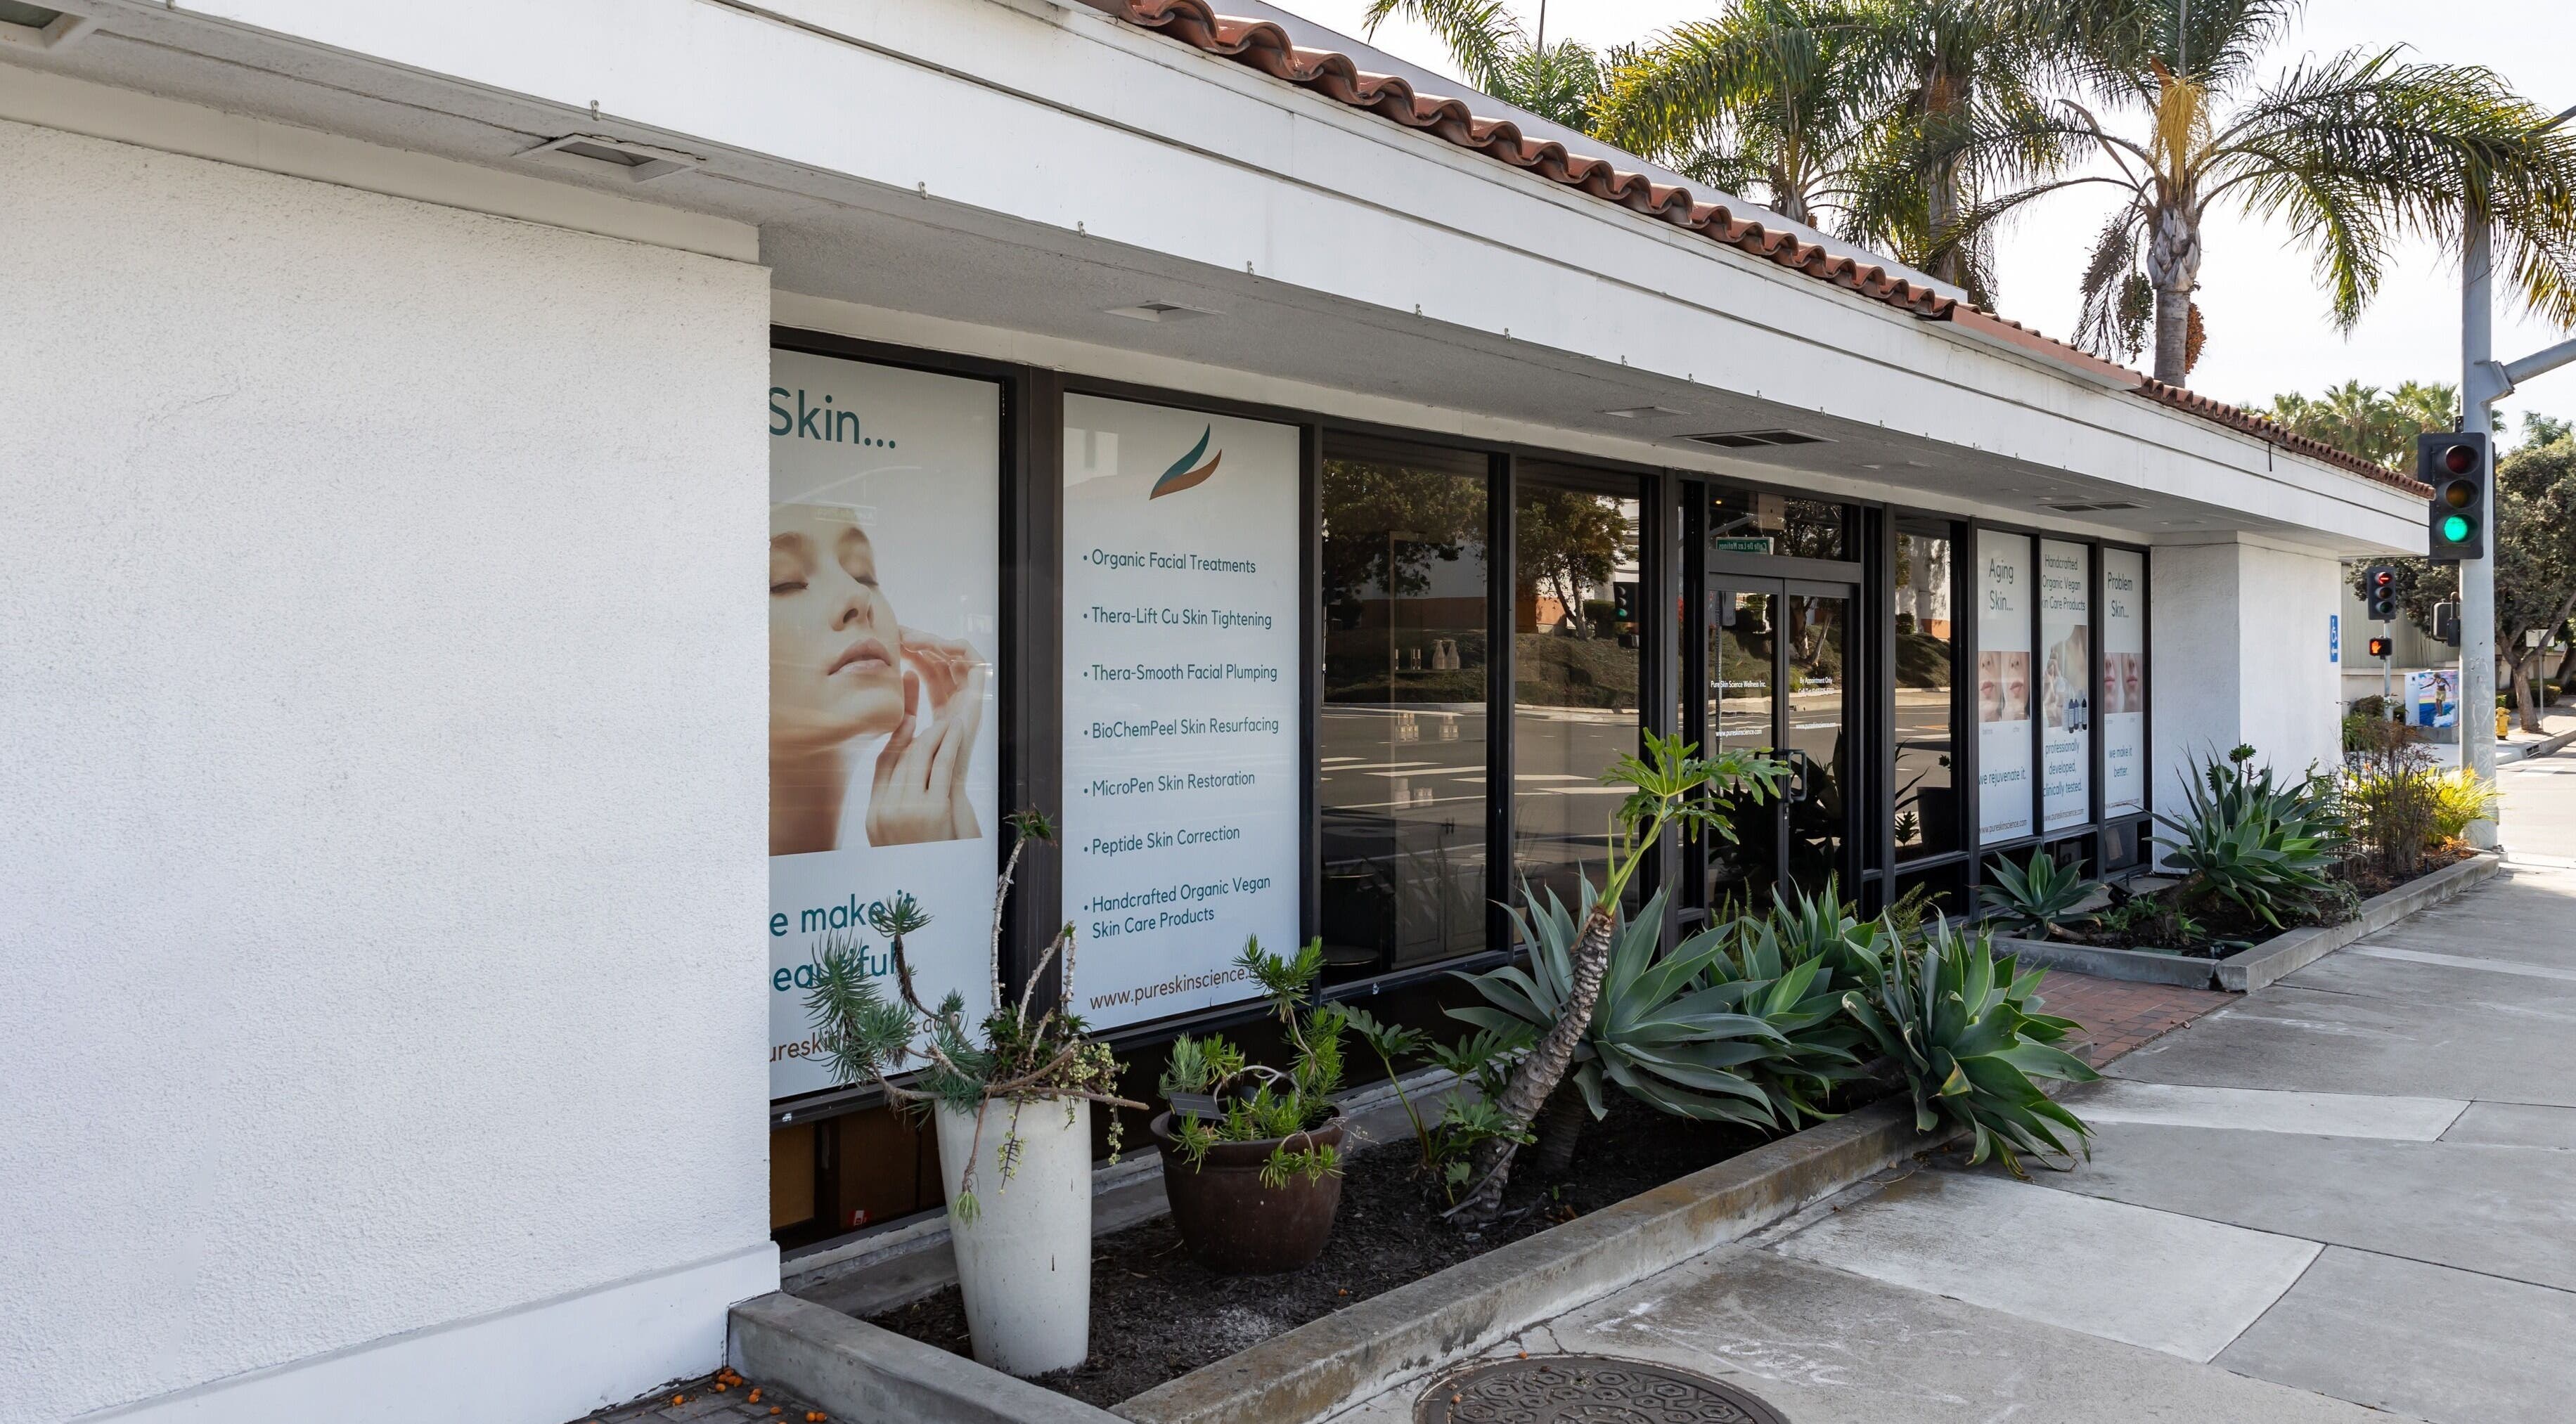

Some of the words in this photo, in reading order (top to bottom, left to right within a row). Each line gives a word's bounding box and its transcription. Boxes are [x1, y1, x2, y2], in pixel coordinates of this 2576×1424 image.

[1092, 549, 1145, 569] Organic
[1150, 552, 1186, 569] Facial
[1190, 555, 1256, 573] Treatments
[1989, 558, 2014, 584] Aging
[2045, 554, 2078, 570] Handcrafted
[2042, 574, 2062, 591] Organic
[2064, 576, 2080, 593] Vegan
[2108, 572, 2132, 590] Problem
[1990, 590, 2013, 611] Skin...
[2050, 596, 2062, 609] Care
[2063, 597, 2085, 611] Products
[1092, 607, 1158, 624] Thera-Lift
[1162, 609, 1178, 624] Cu
[1183, 609, 1207, 625] Skin
[1211, 610, 1272, 630] Tightening
[1092, 664, 1183, 680] Thera-Smooth
[1187, 664, 1222, 679] Facial
[1226, 664, 1277, 682] Plumping
[1093, 720, 1177, 738] BioChemPeel
[1181, 719, 1205, 734] Skin
[1210, 717, 1278, 734] Resurfacing
[2045, 739, 2080, 758] professionally
[1093, 777, 1154, 796] MicroPen
[1158, 775, 1183, 791] Skin
[1188, 770, 1255, 789] Restoration
[1989, 769, 2020, 787] rejuvenate
[2066, 778, 2082, 794] tested.
[1093, 834, 1142, 857] Peptide
[1147, 831, 1173, 848] Skin
[1178, 825, 1239, 845] Correction
[1093, 886, 1176, 912] Handcrafted
[1181, 880, 1228, 901] Organic
[1232, 877, 1270, 893] Vegan
[801, 893, 885, 933] make
[1093, 921, 1119, 938] Skin
[1125, 917, 1156, 933] Care
[1160, 908, 1214, 928] Products
